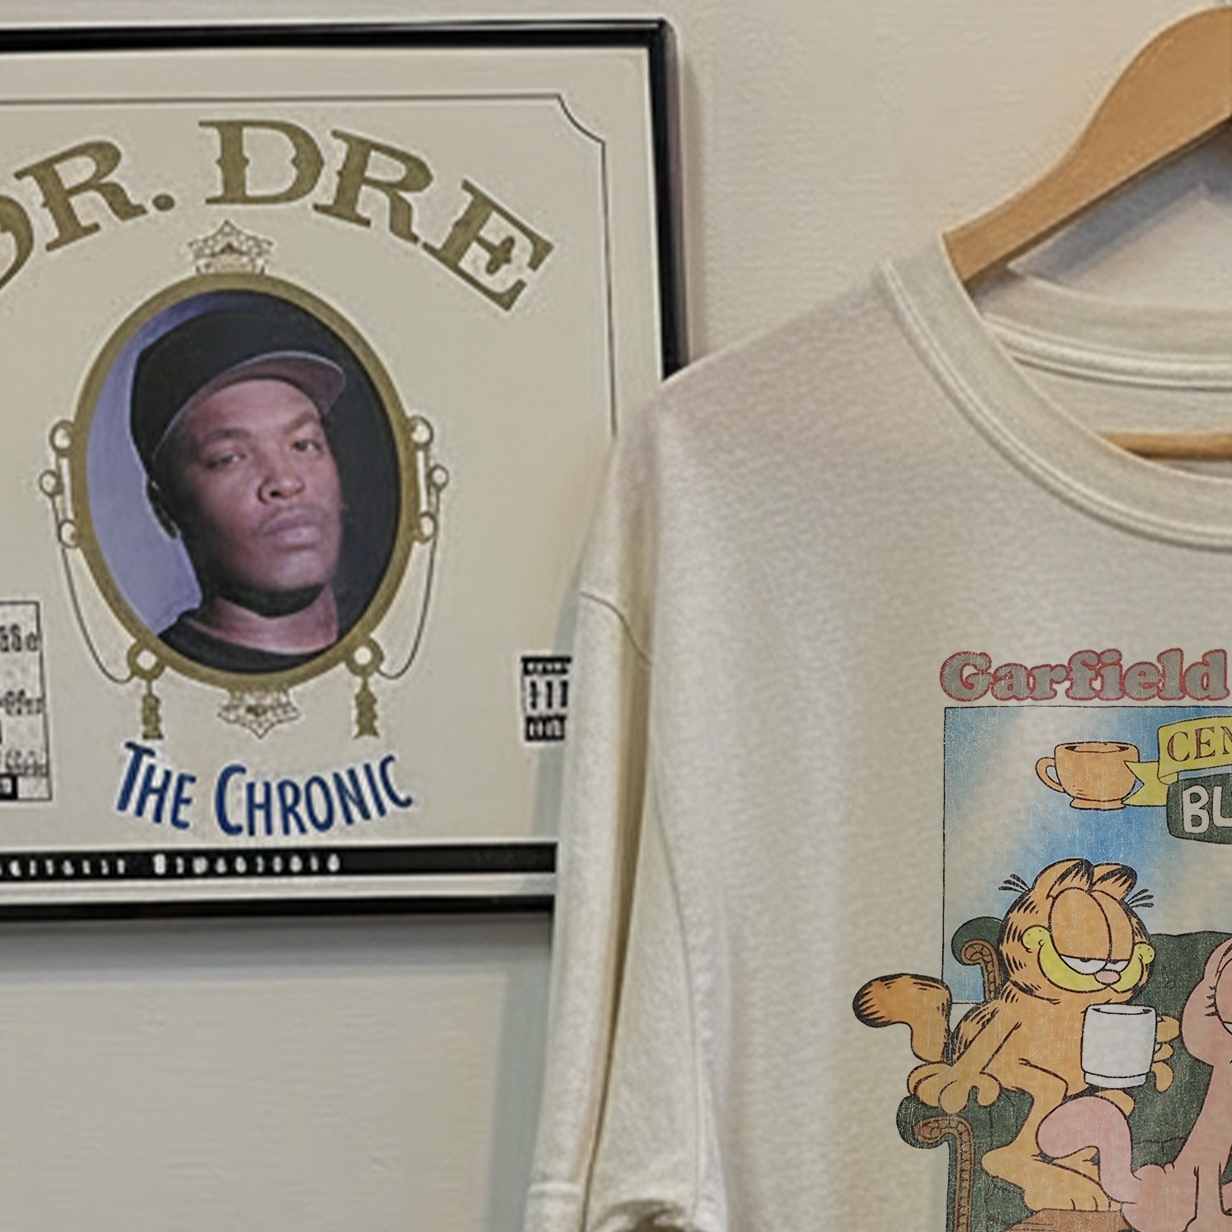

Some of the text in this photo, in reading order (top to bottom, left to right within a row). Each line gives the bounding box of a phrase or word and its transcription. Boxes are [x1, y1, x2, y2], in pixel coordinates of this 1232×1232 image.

[198, 119, 554, 312] DRE
[940, 649, 1230, 701] Garfield
[115, 741, 413, 836] THE CHRONIC
